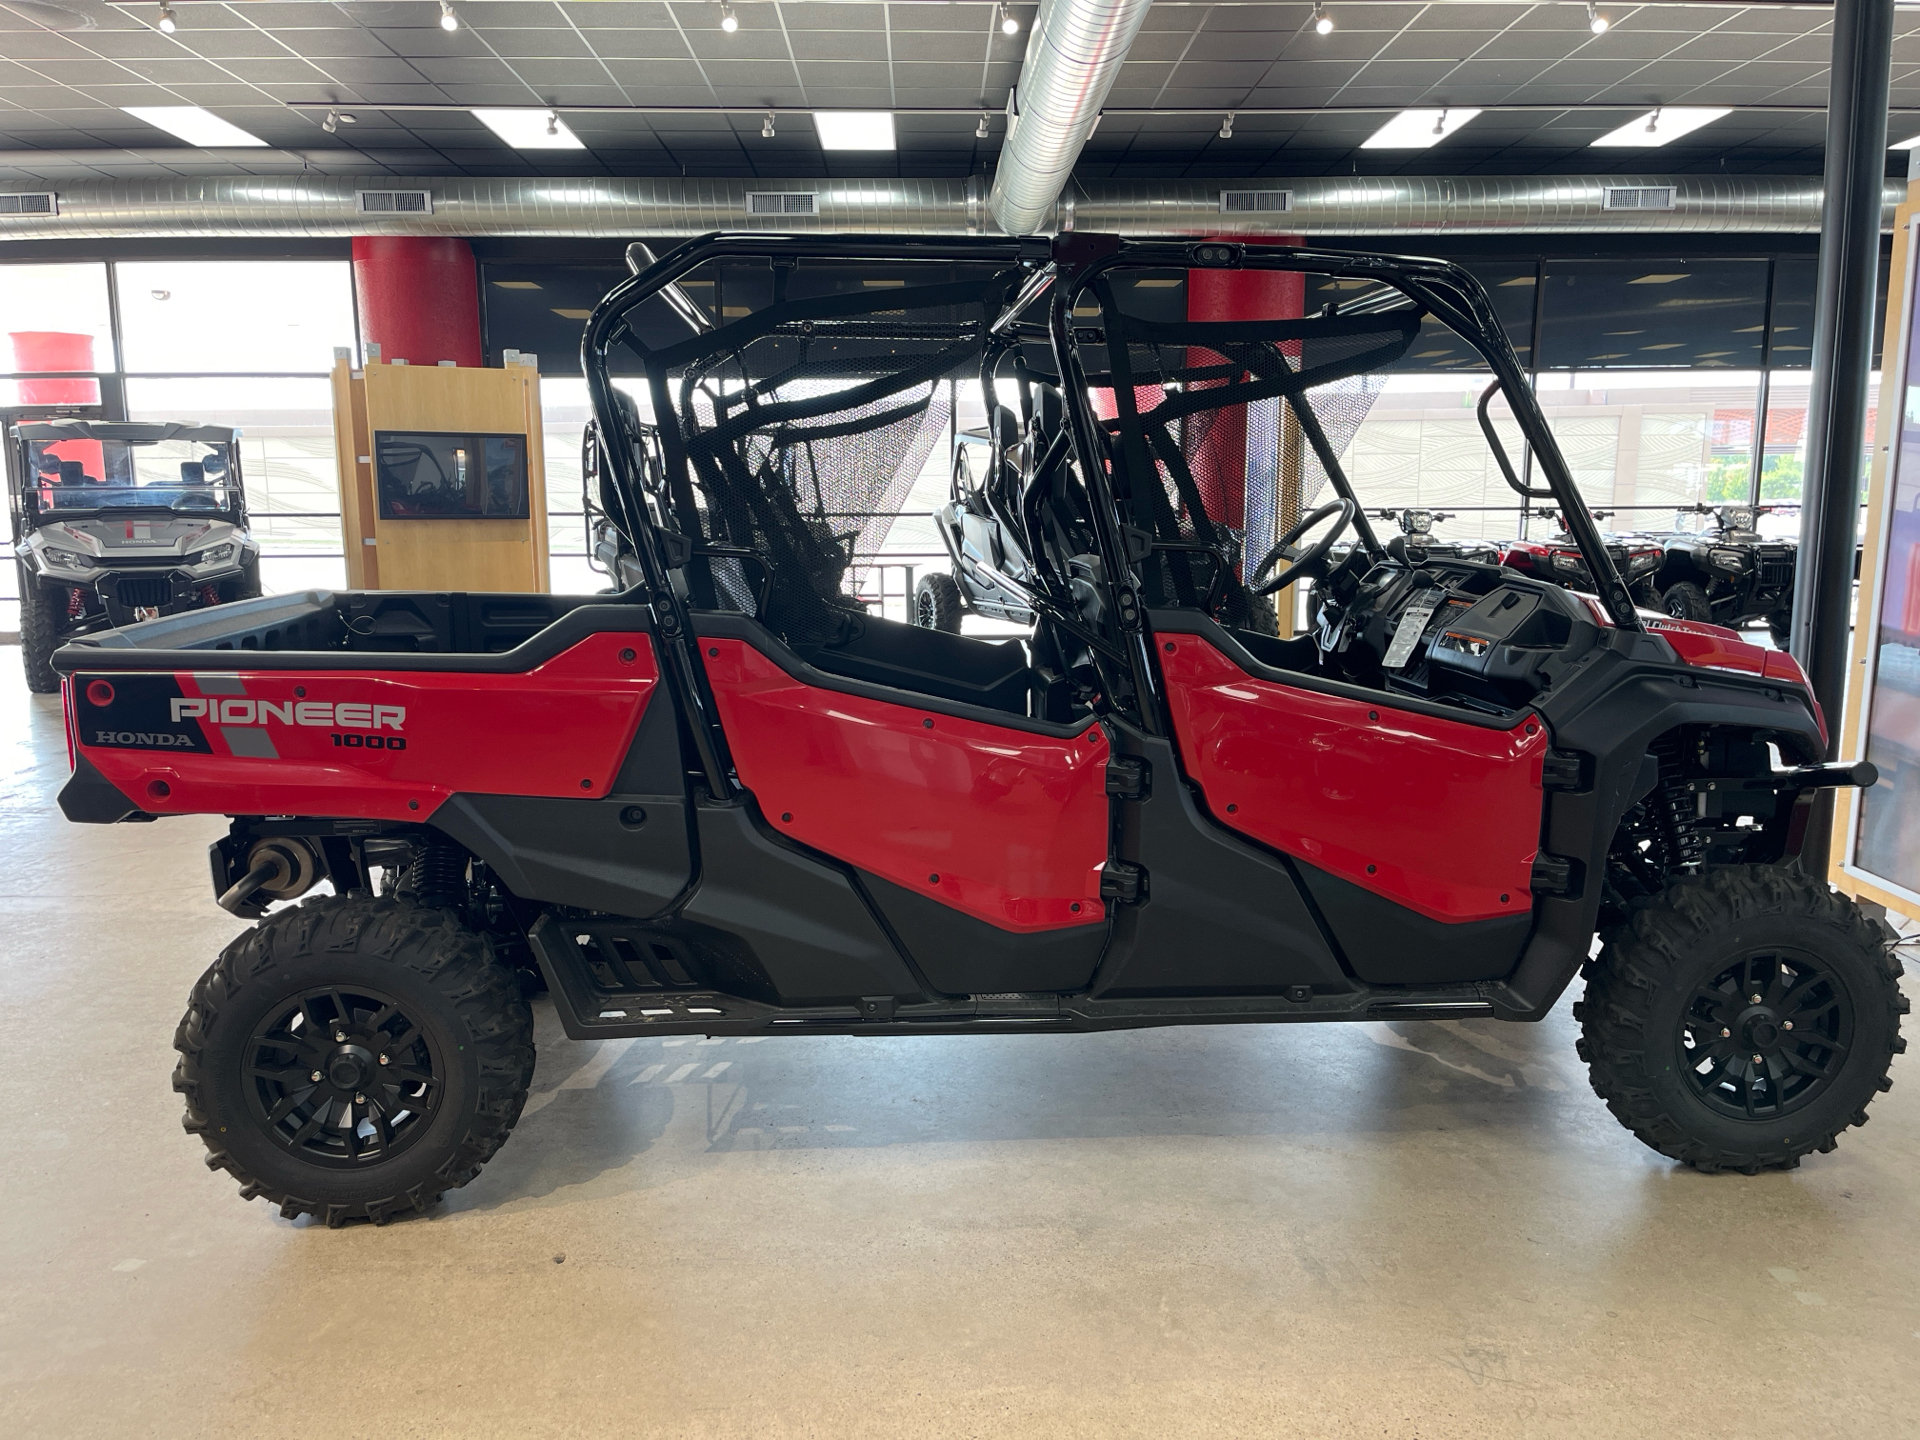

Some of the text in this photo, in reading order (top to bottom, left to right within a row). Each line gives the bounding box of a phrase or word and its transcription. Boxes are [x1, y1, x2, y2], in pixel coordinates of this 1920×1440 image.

[170, 697, 406, 731] PIONEER
[95, 730, 195, 747] HONDA
[330, 732, 407, 750] 1000
